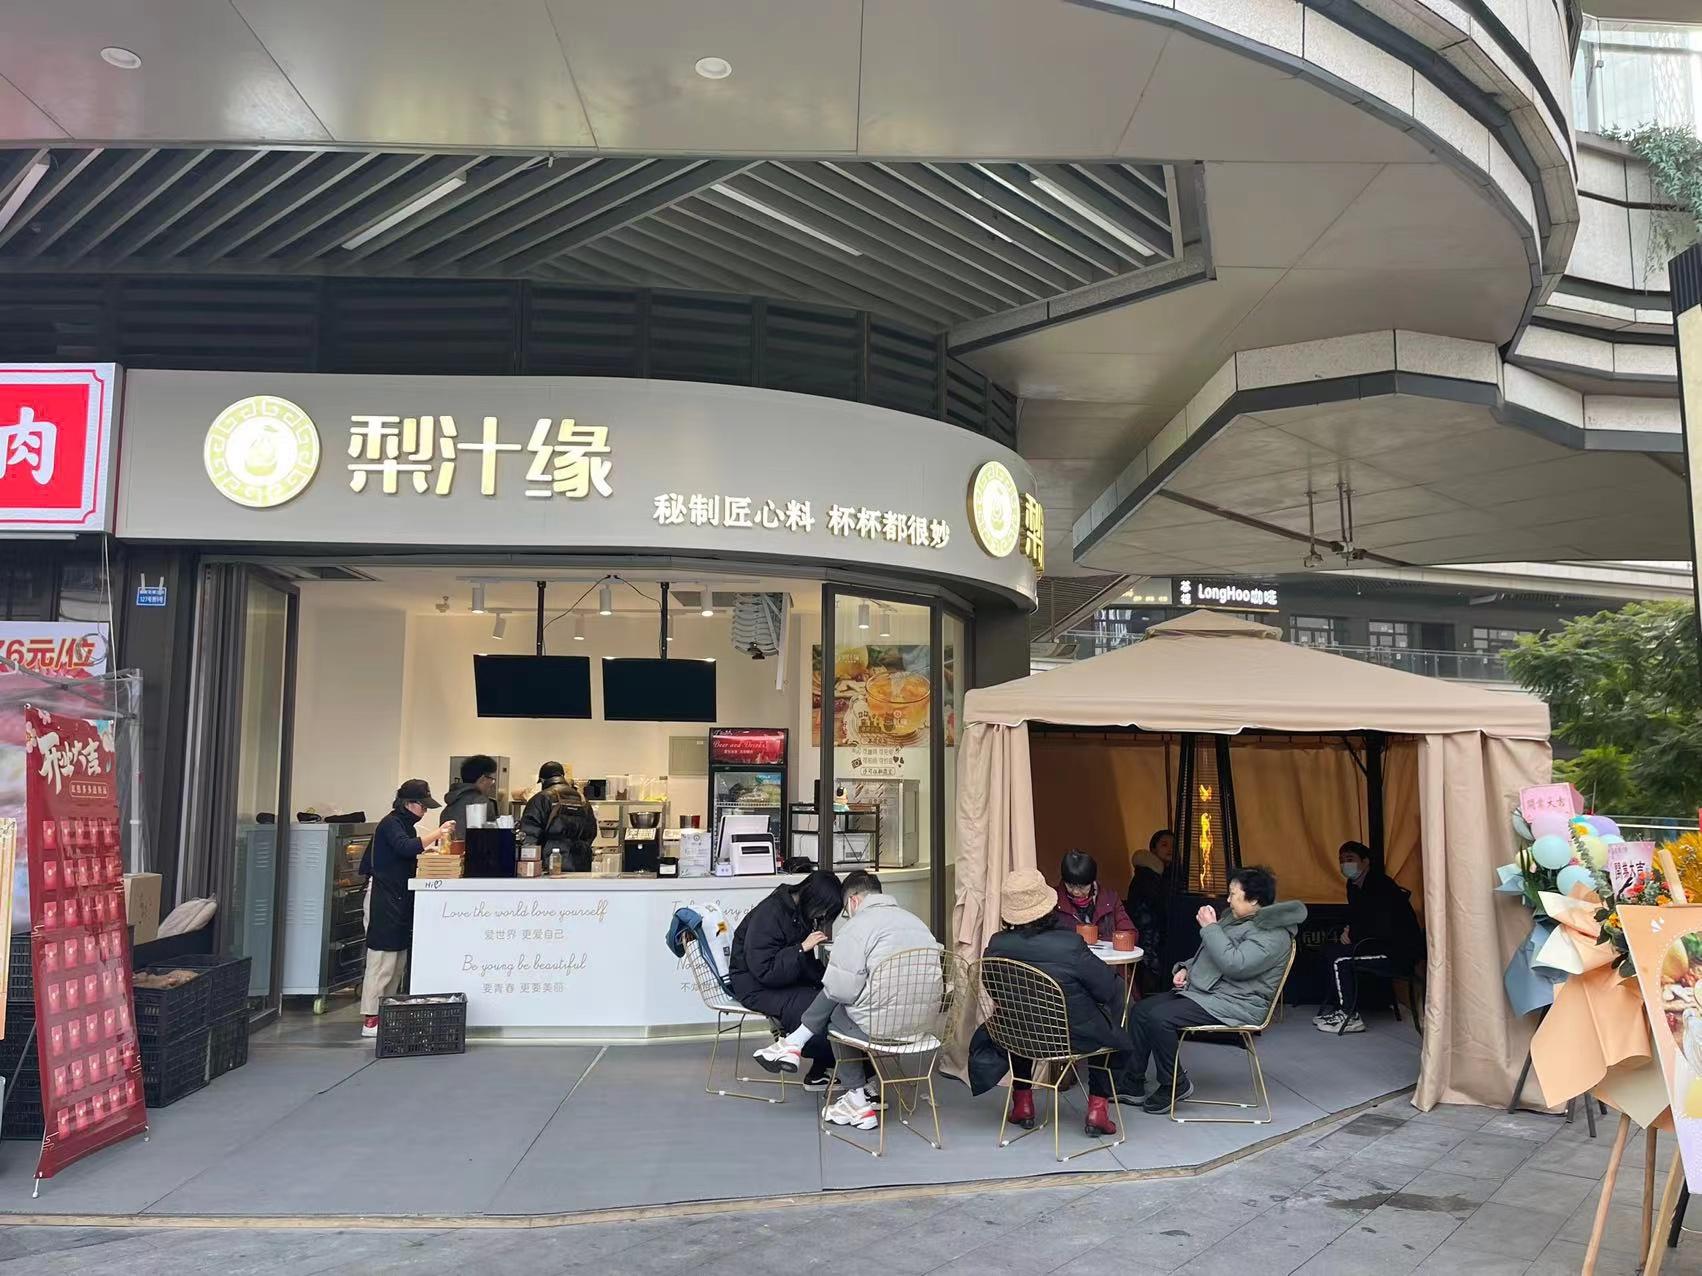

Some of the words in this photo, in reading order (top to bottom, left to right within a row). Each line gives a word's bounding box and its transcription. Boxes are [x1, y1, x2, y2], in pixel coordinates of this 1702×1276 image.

[0, 406, 57, 485] 肉
[347, 415, 613, 499] 梨汁缘
[653, 493, 815, 533] 秘制匠心料
[827, 503, 951, 549] 杯杯都很妙
[442, 901, 471, 918] Love
[472, 901, 491, 918] the
[494, 900, 530, 918] world
[530, 900, 557, 918] love
[558, 899, 609, 922] yourself
[484, 928, 517, 941] 爱世界
[522, 928, 565, 941] 更爱自己
[462, 954, 477, 971] Be
[480, 961, 514, 977] young
[517, 953, 530, 971] be
[533, 953, 587, 977] beautiful
